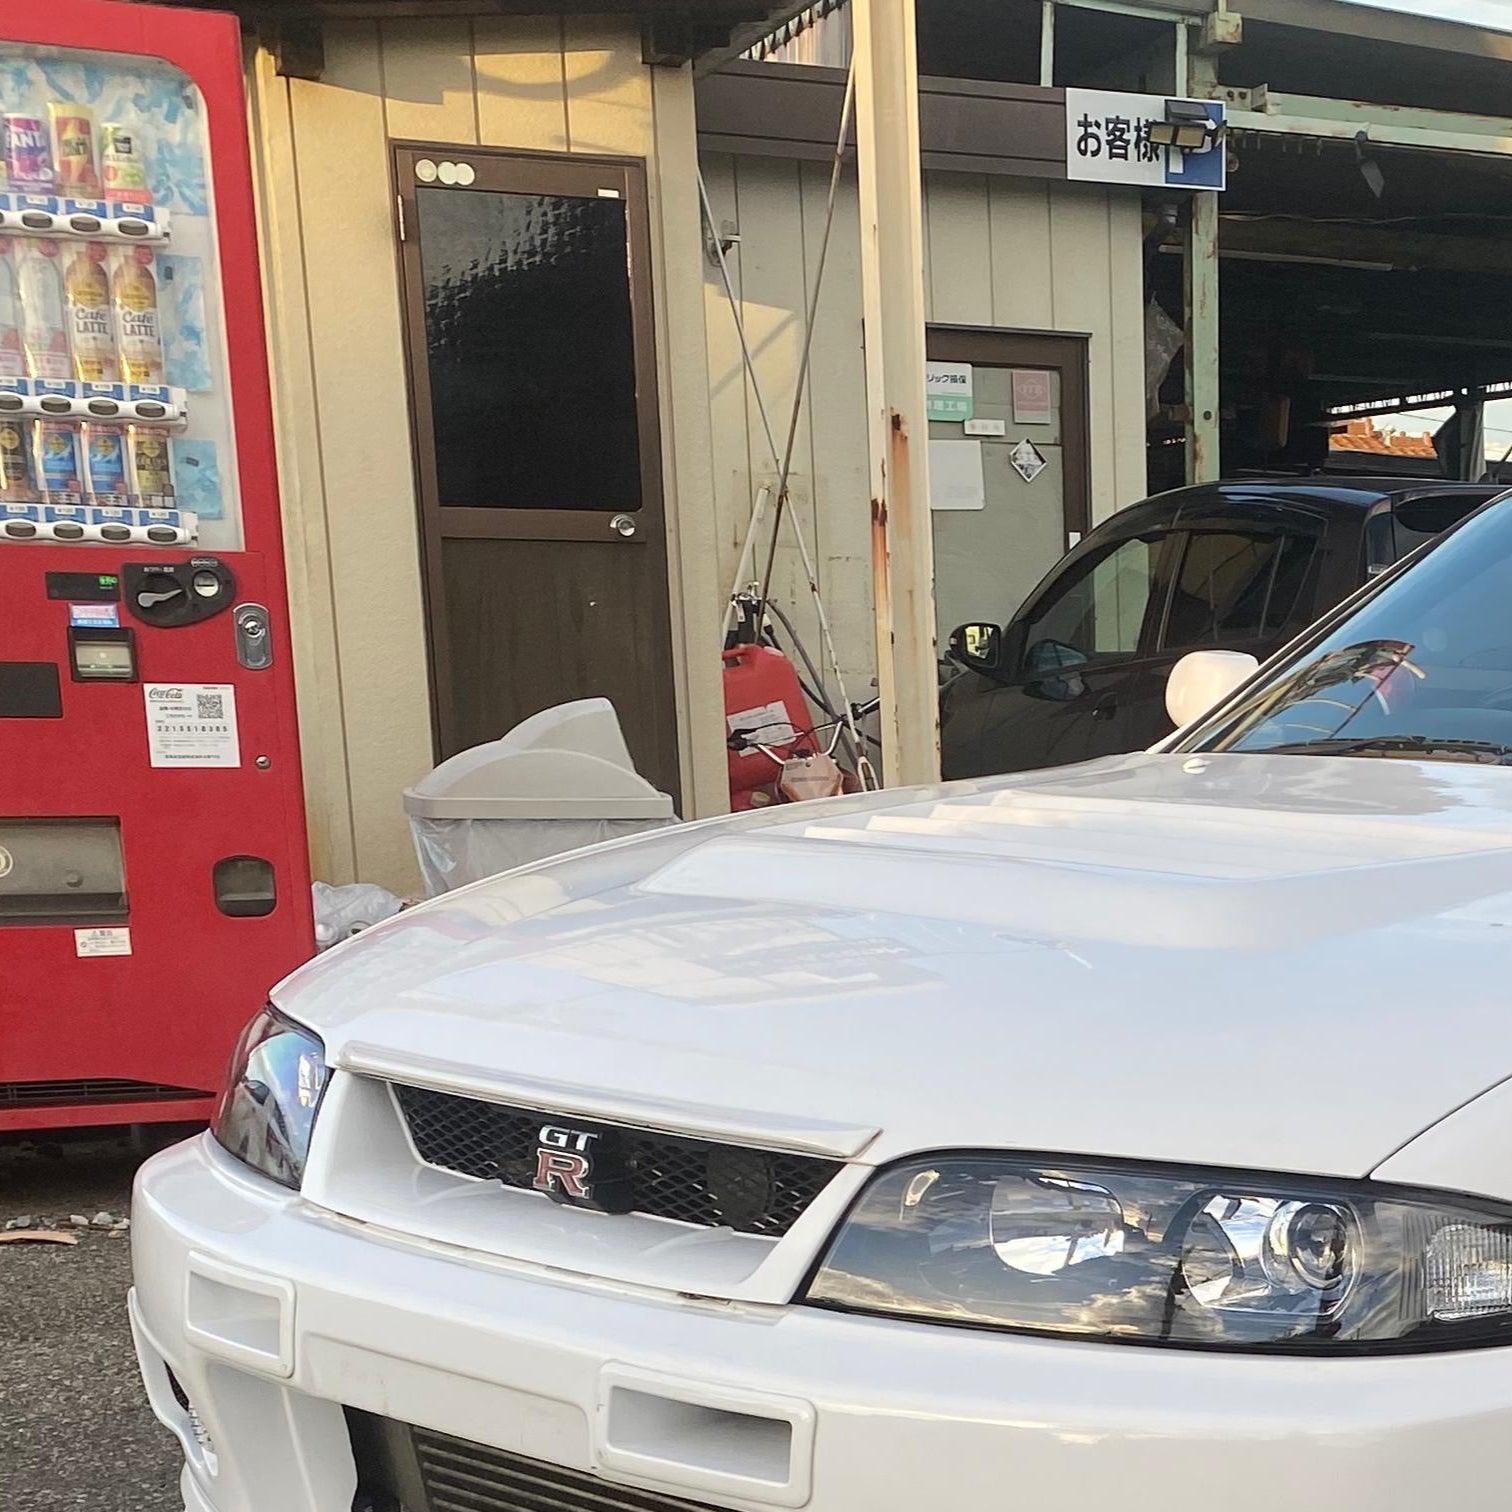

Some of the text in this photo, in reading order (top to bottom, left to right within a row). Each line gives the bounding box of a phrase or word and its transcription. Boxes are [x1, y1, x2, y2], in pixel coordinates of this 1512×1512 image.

[76, 321, 108, 334] LATTE
[123, 323, 156, 336] LATTE
[539, 1124, 599, 1151] GT
[533, 1148, 590, 1199] R
